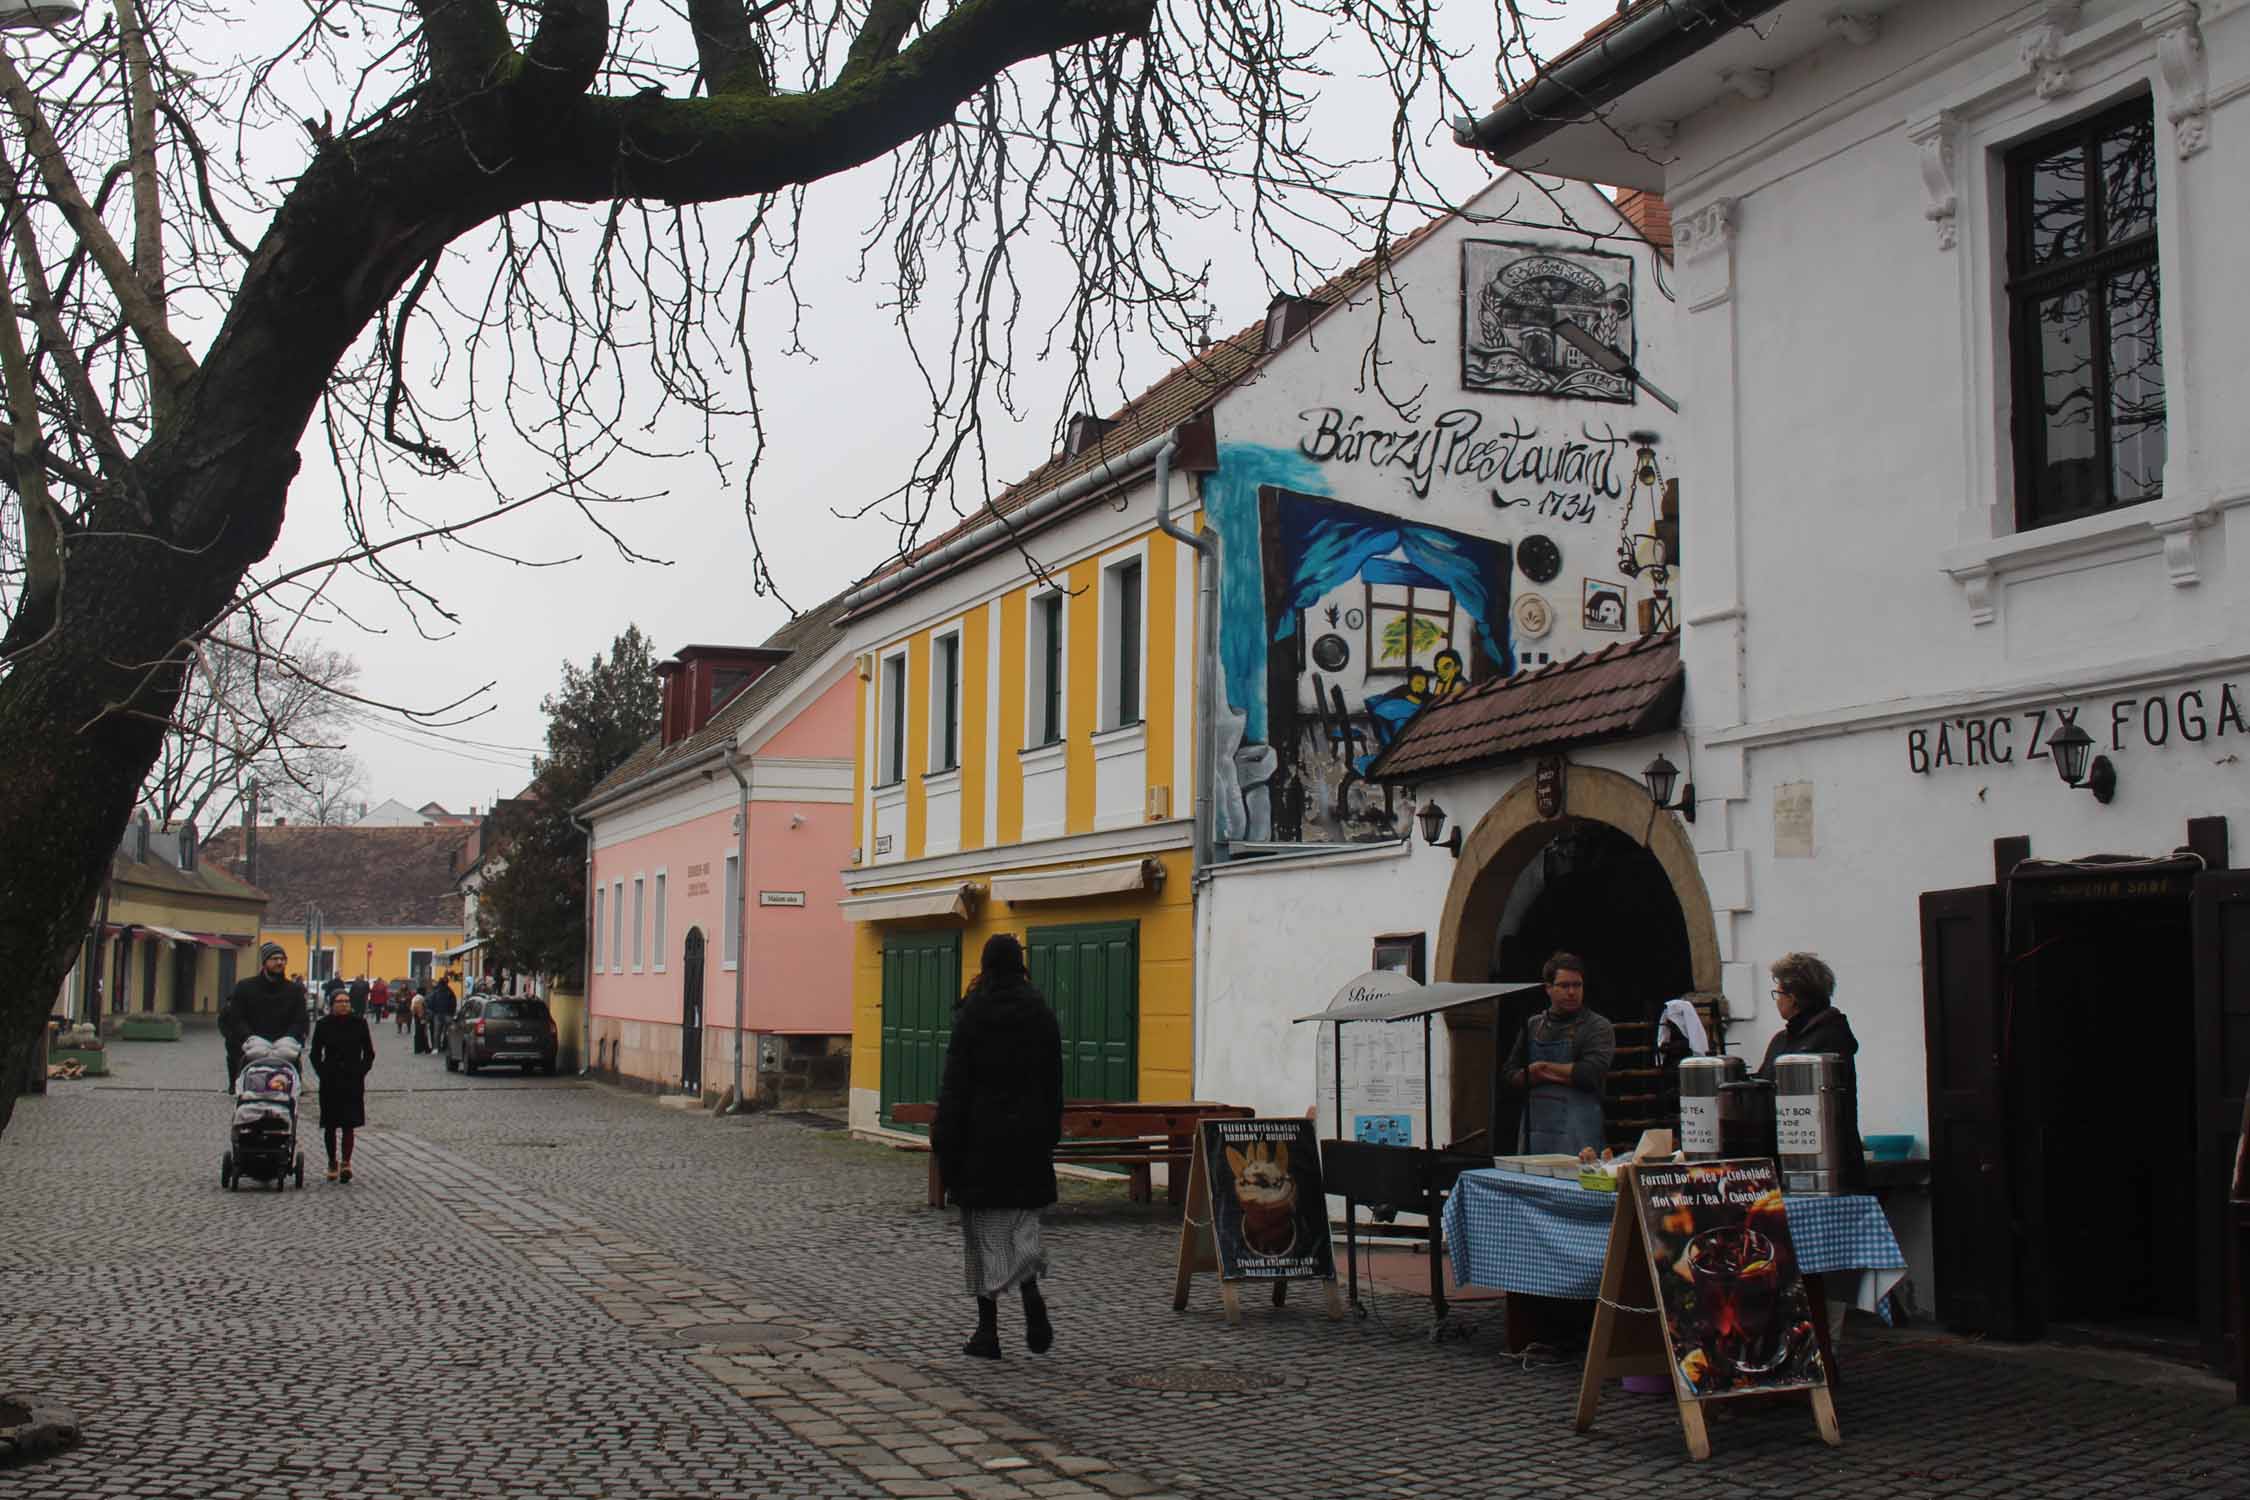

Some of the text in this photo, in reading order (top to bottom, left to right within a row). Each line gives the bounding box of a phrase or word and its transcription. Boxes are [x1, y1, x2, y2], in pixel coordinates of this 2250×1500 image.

[1299, 407, 1629, 500] Bárczy Restaurant
[1537, 489, 1596, 524] 1734
[1640, 1173, 1673, 1186] Forralt
[1675, 1172, 1691, 1184] bor
[1701, 1171, 1718, 1183] Tea
[1651, 1195, 1669, 1208] Hot
[1671, 1194, 1694, 1206] wine
[1701, 1193, 1719, 1206] Tea
